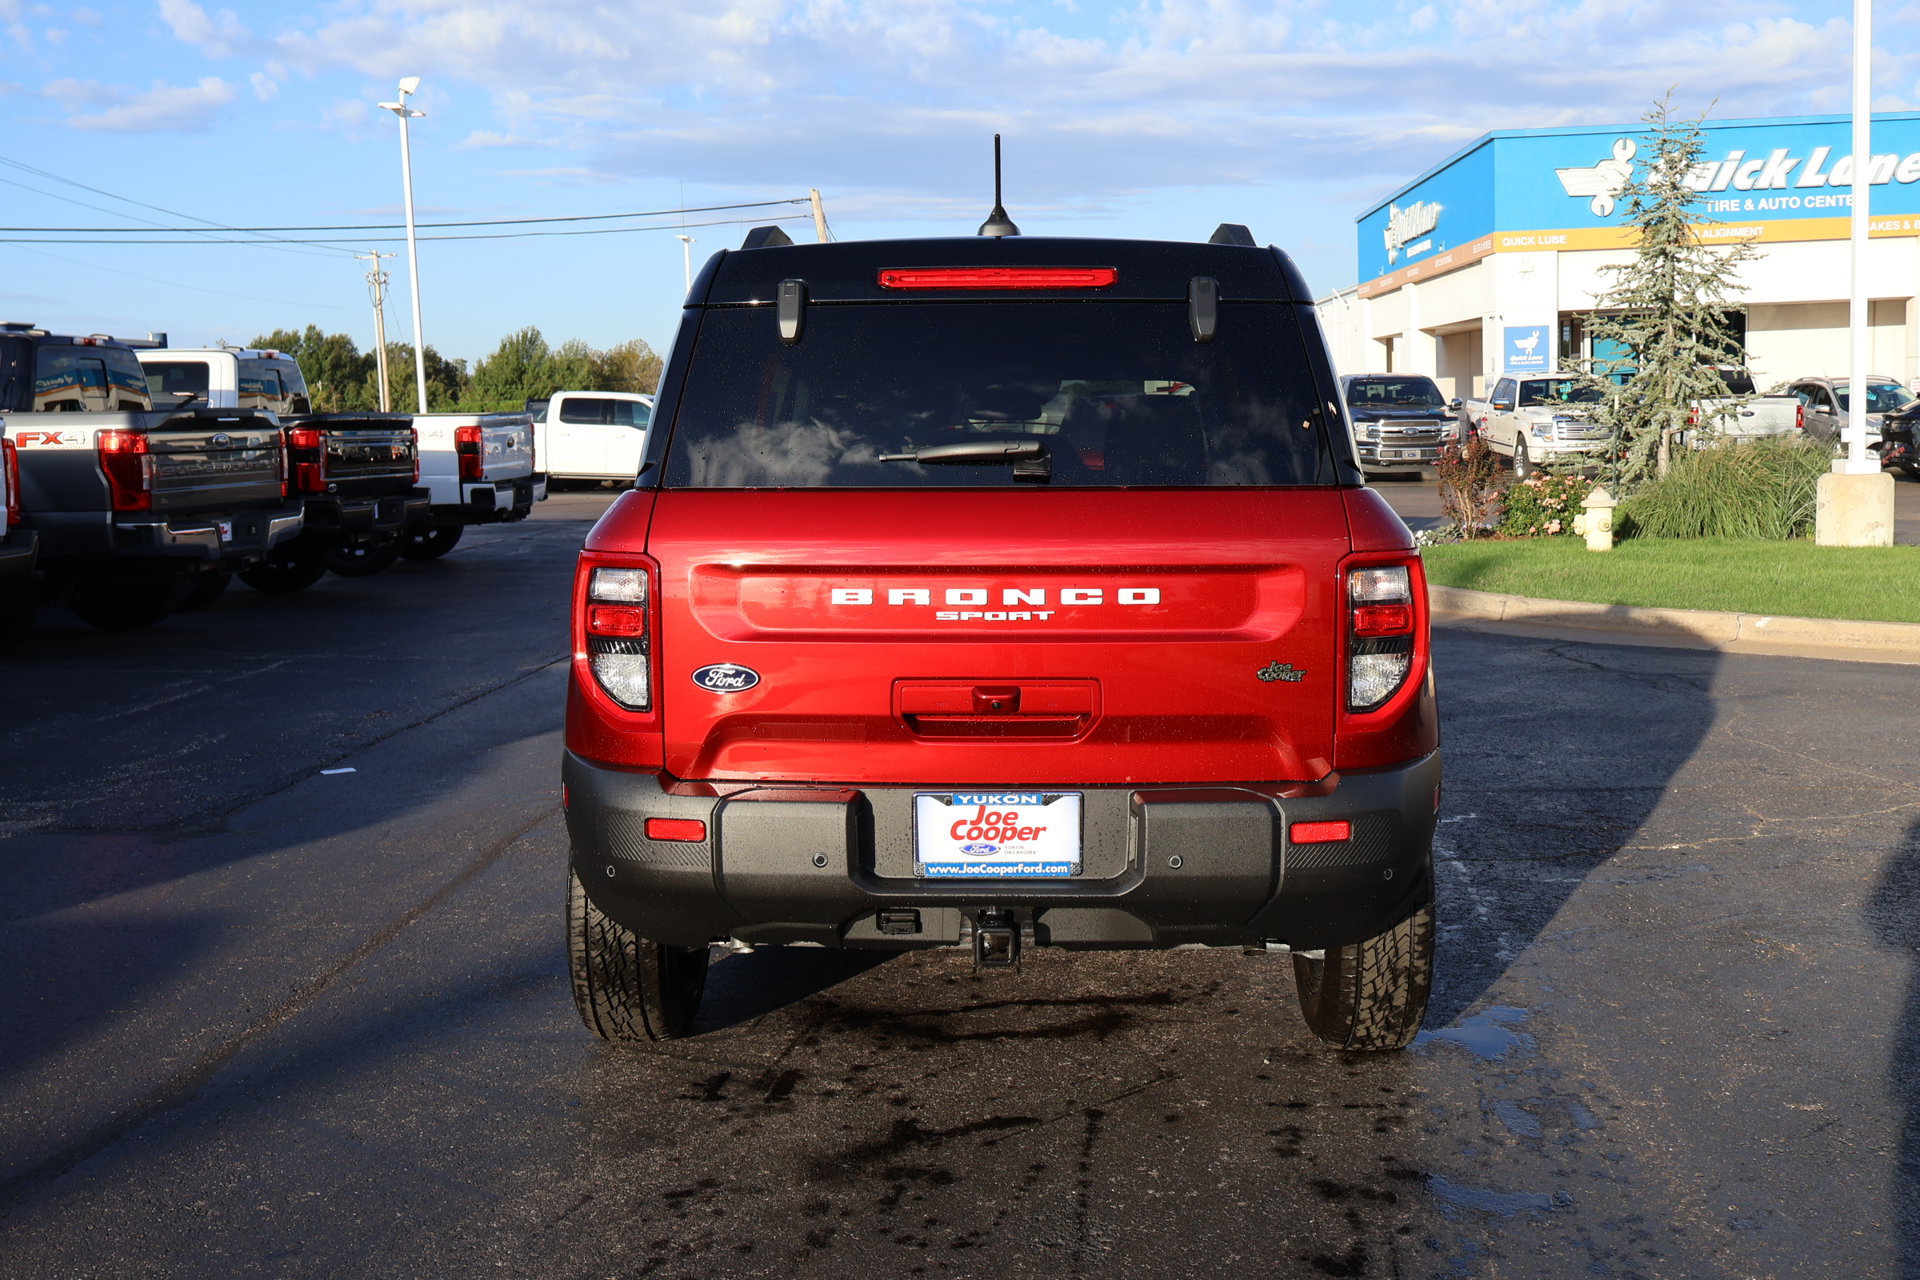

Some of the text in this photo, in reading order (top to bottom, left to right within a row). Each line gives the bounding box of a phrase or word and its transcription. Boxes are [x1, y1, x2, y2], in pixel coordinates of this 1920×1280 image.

[1706, 194, 1854, 213] TIRE & AUTO CENTE
[1868, 220, 1901, 231] AKES
[1702, 226, 1764, 239] ALIGNMENT
[1502, 236, 1536, 247] QUICK
[1538, 234, 1567, 245] LUBE
[16, 431, 86, 448] FX4
[831, 588, 1161, 606] BRONCO
[936, 611, 1055, 621] SPORT
[1267, 660, 1293, 672] Joe
[705, 668, 746, 687] Ford
[957, 794, 1038, 804] YUKON
[969, 805, 1019, 826] Joe
[950, 819, 1047, 844] Cooper
[928, 864, 1068, 876] www.JoeCooperFord.com
